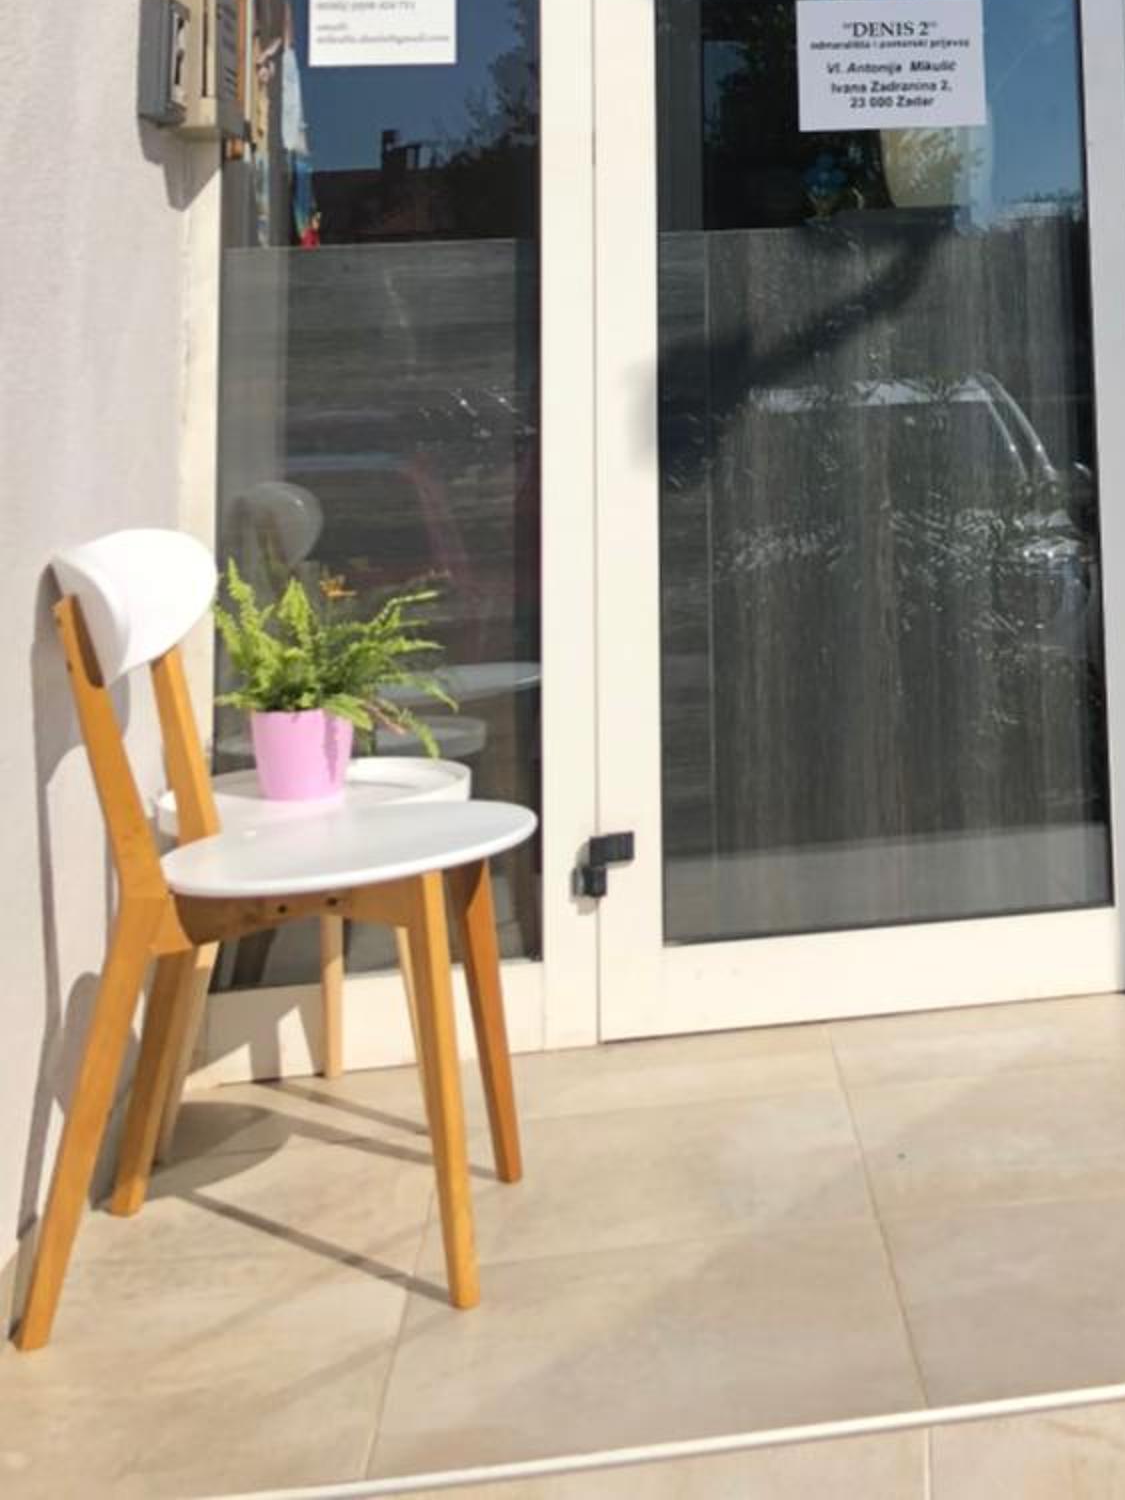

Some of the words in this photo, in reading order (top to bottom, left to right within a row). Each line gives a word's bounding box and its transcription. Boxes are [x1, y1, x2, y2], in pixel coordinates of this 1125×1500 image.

[831, 82, 867, 94] Ivana
[870, 80, 937, 94] Zadranina
[896, 95, 934, 108] Zadar
